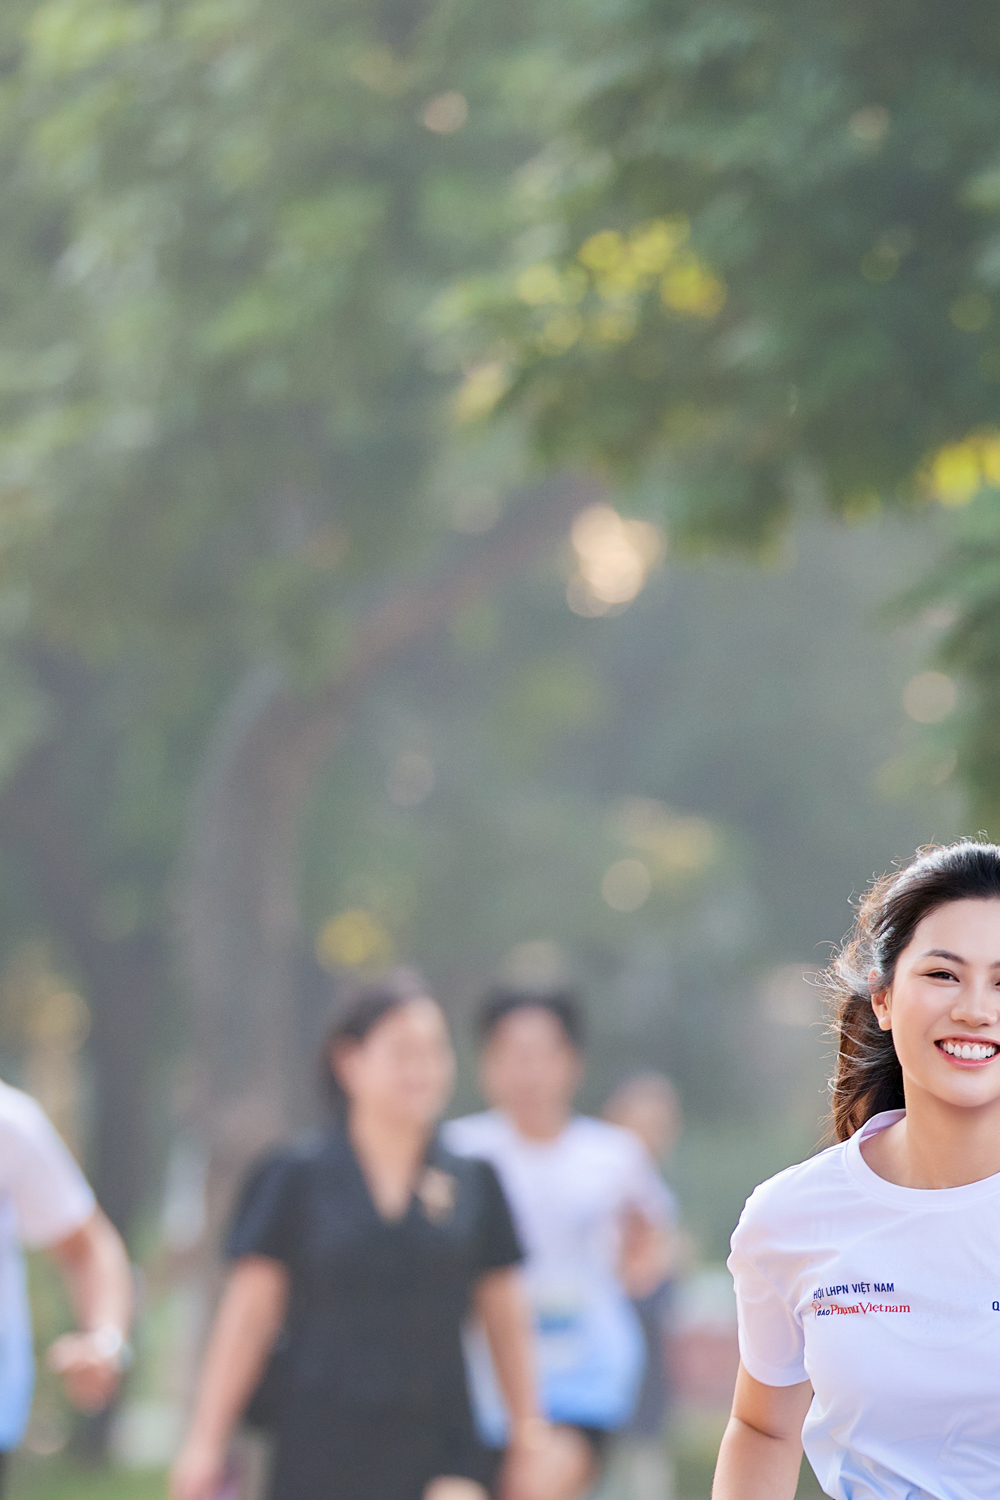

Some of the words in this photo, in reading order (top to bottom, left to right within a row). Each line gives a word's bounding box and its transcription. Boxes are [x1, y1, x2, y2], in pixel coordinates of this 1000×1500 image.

[813, 1287, 824, 1300] HỘI
[826, 1284, 849, 1296] LHPN
[852, 1282, 870, 1295] VIỆT
[874, 1283, 894, 1292] NAM
